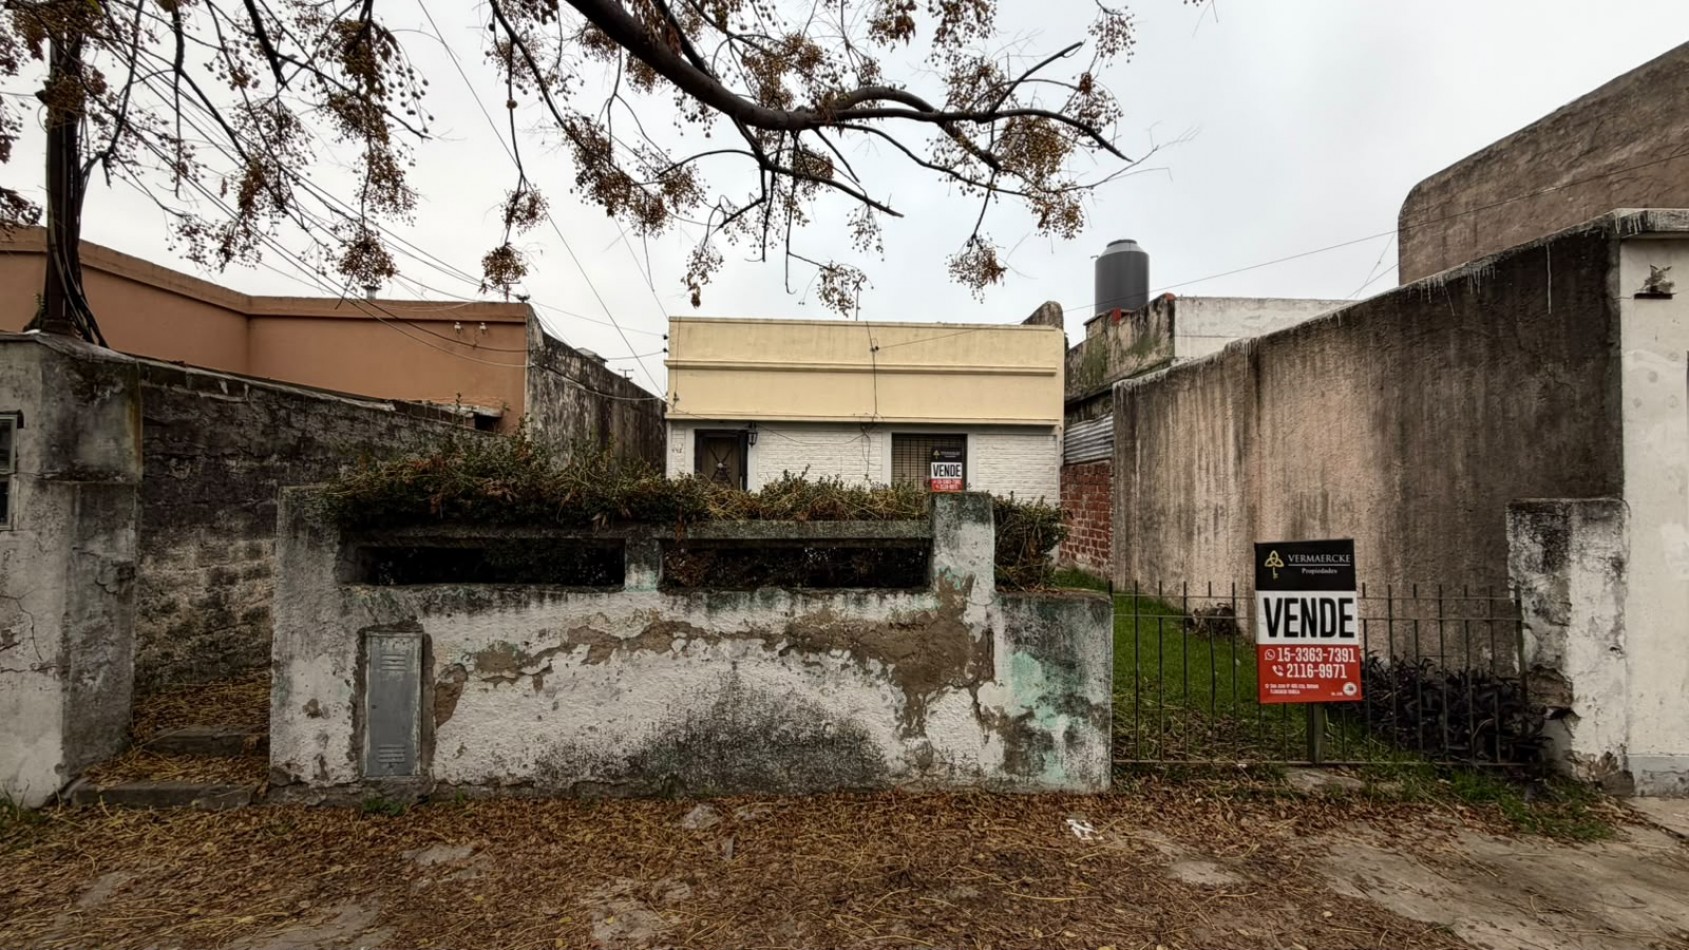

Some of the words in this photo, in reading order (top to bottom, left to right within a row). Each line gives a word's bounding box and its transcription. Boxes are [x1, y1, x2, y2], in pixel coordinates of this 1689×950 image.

[932, 464, 961, 477] VENDE
[1288, 554, 1351, 563] VERMAERCKE
[1263, 597, 1355, 638] VENDE
[1277, 647, 1356, 663] 15-3363-7391
[1286, 663, 1347, 679] 2116-9971
